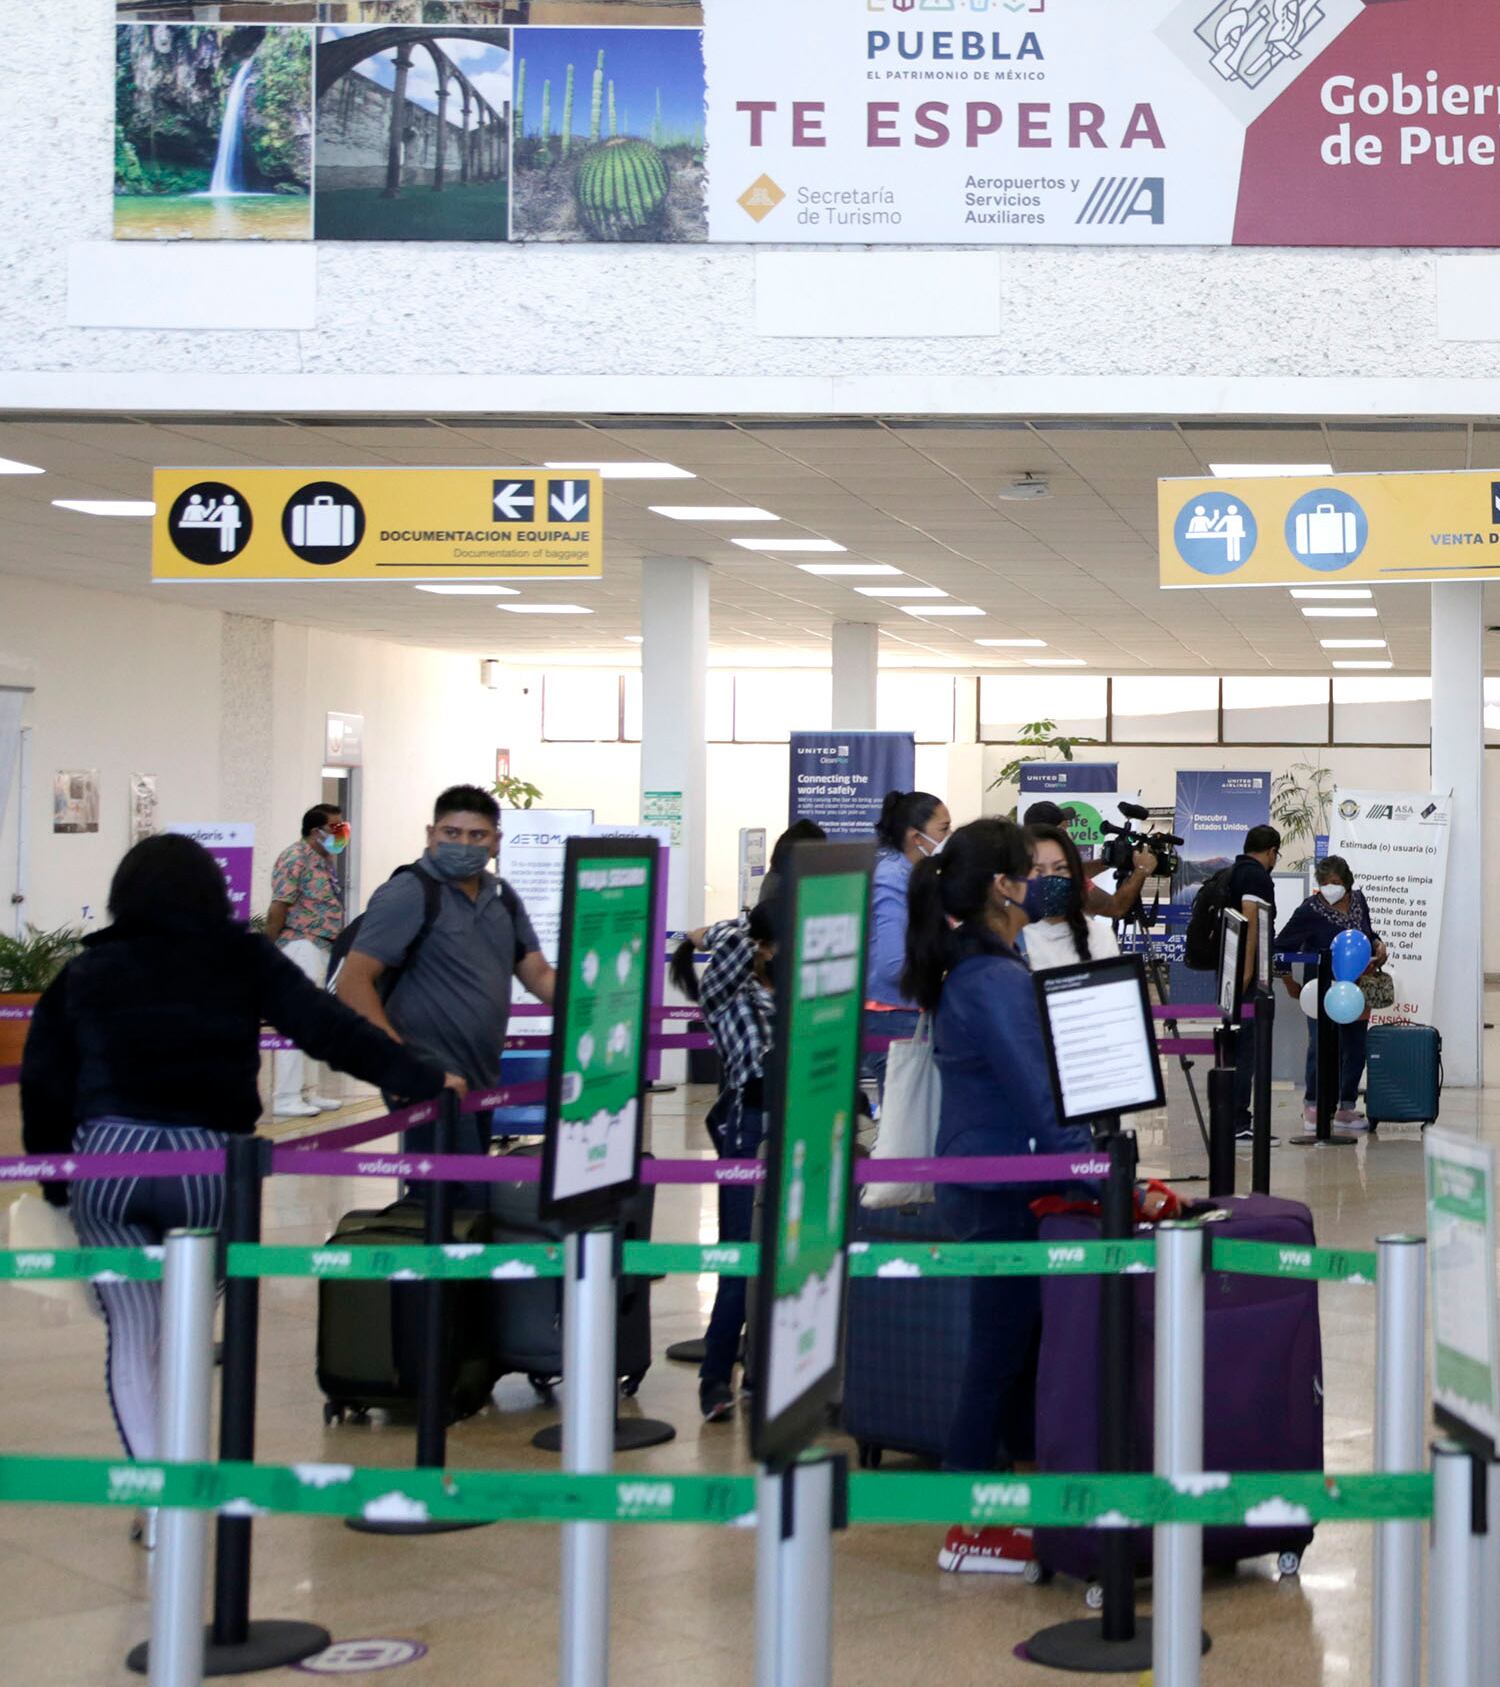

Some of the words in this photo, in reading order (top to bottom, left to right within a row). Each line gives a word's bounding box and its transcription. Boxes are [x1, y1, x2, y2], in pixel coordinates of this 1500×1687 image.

[867, 30, 1045, 60] PUEBLA
[867, 71, 881, 79] EL
[886, 71, 968, 80] PATRIMONIO
[973, 72, 990, 80] DE
[995, 69, 1045, 80] MÉXICO
[736, 101, 826, 147] TE
[866, 101, 1166, 149] ESPERA
[1320, 122, 1383, 166] de
[965, 176, 1065, 193] Aeropuertos
[1070, 177, 1080, 192] y
[797, 186, 894, 205] Secretaría
[965, 193, 1041, 207] Servicios
[797, 208, 820, 224] de
[826, 209, 902, 225] Turismo
[965, 210, 1045, 224] Auxiliares
[380, 531, 511, 542] DOCUMENTACION
[516, 530, 590, 542] EQUIPAJE
[1431, 534, 1484, 545] VENTA
[453, 548, 529, 558] Documentation
[532, 548, 543, 558] of
[545, 548, 589, 560] baggage
[797, 774, 850, 784] Connecting
[852, 775, 868, 783] the
[797, 786, 825, 795] world
[827, 786, 857, 796] safely
[1067, 814, 1088, 827] afe
[1194, 814, 1227, 822] Descubra
[1194, 823, 1221, 831] Estados
[1071, 828, 1098, 840] vels
[1340, 840, 1377, 850] Estimada
[1379, 842, 1391, 852] (o)
[1392, 844, 1423, 853] usuaria
[1425, 845, 1437, 855] (o)
[1353, 873, 1394, 883] eropuerto
[1408, 875, 1433, 884] limpia
[1365, 884, 1409, 893] desinfecta
[1366, 896, 1407, 905] ntemente,
[1395, 908, 1427, 917] durante
[1393, 919, 1413, 927] toma
[1399, 941, 1413, 949] Gel
[1392, 950, 1400, 959] la
[1402, 953, 1422, 961] sana
[1403, 1003, 1418, 1013] SU
[1368, 1014, 1411, 1026] ENSIÓN
[260, 1037, 281, 1048] aris
[358, 1159, 413, 1175] volaris
[1070, 1159, 1112, 1174] volar
[1047, 1246, 1085, 1262] viva
[1279, 1249, 1312, 1266] viva
[971, 1482, 1031, 1506] viva
[951, 1542, 1002, 1557] TOMMY
